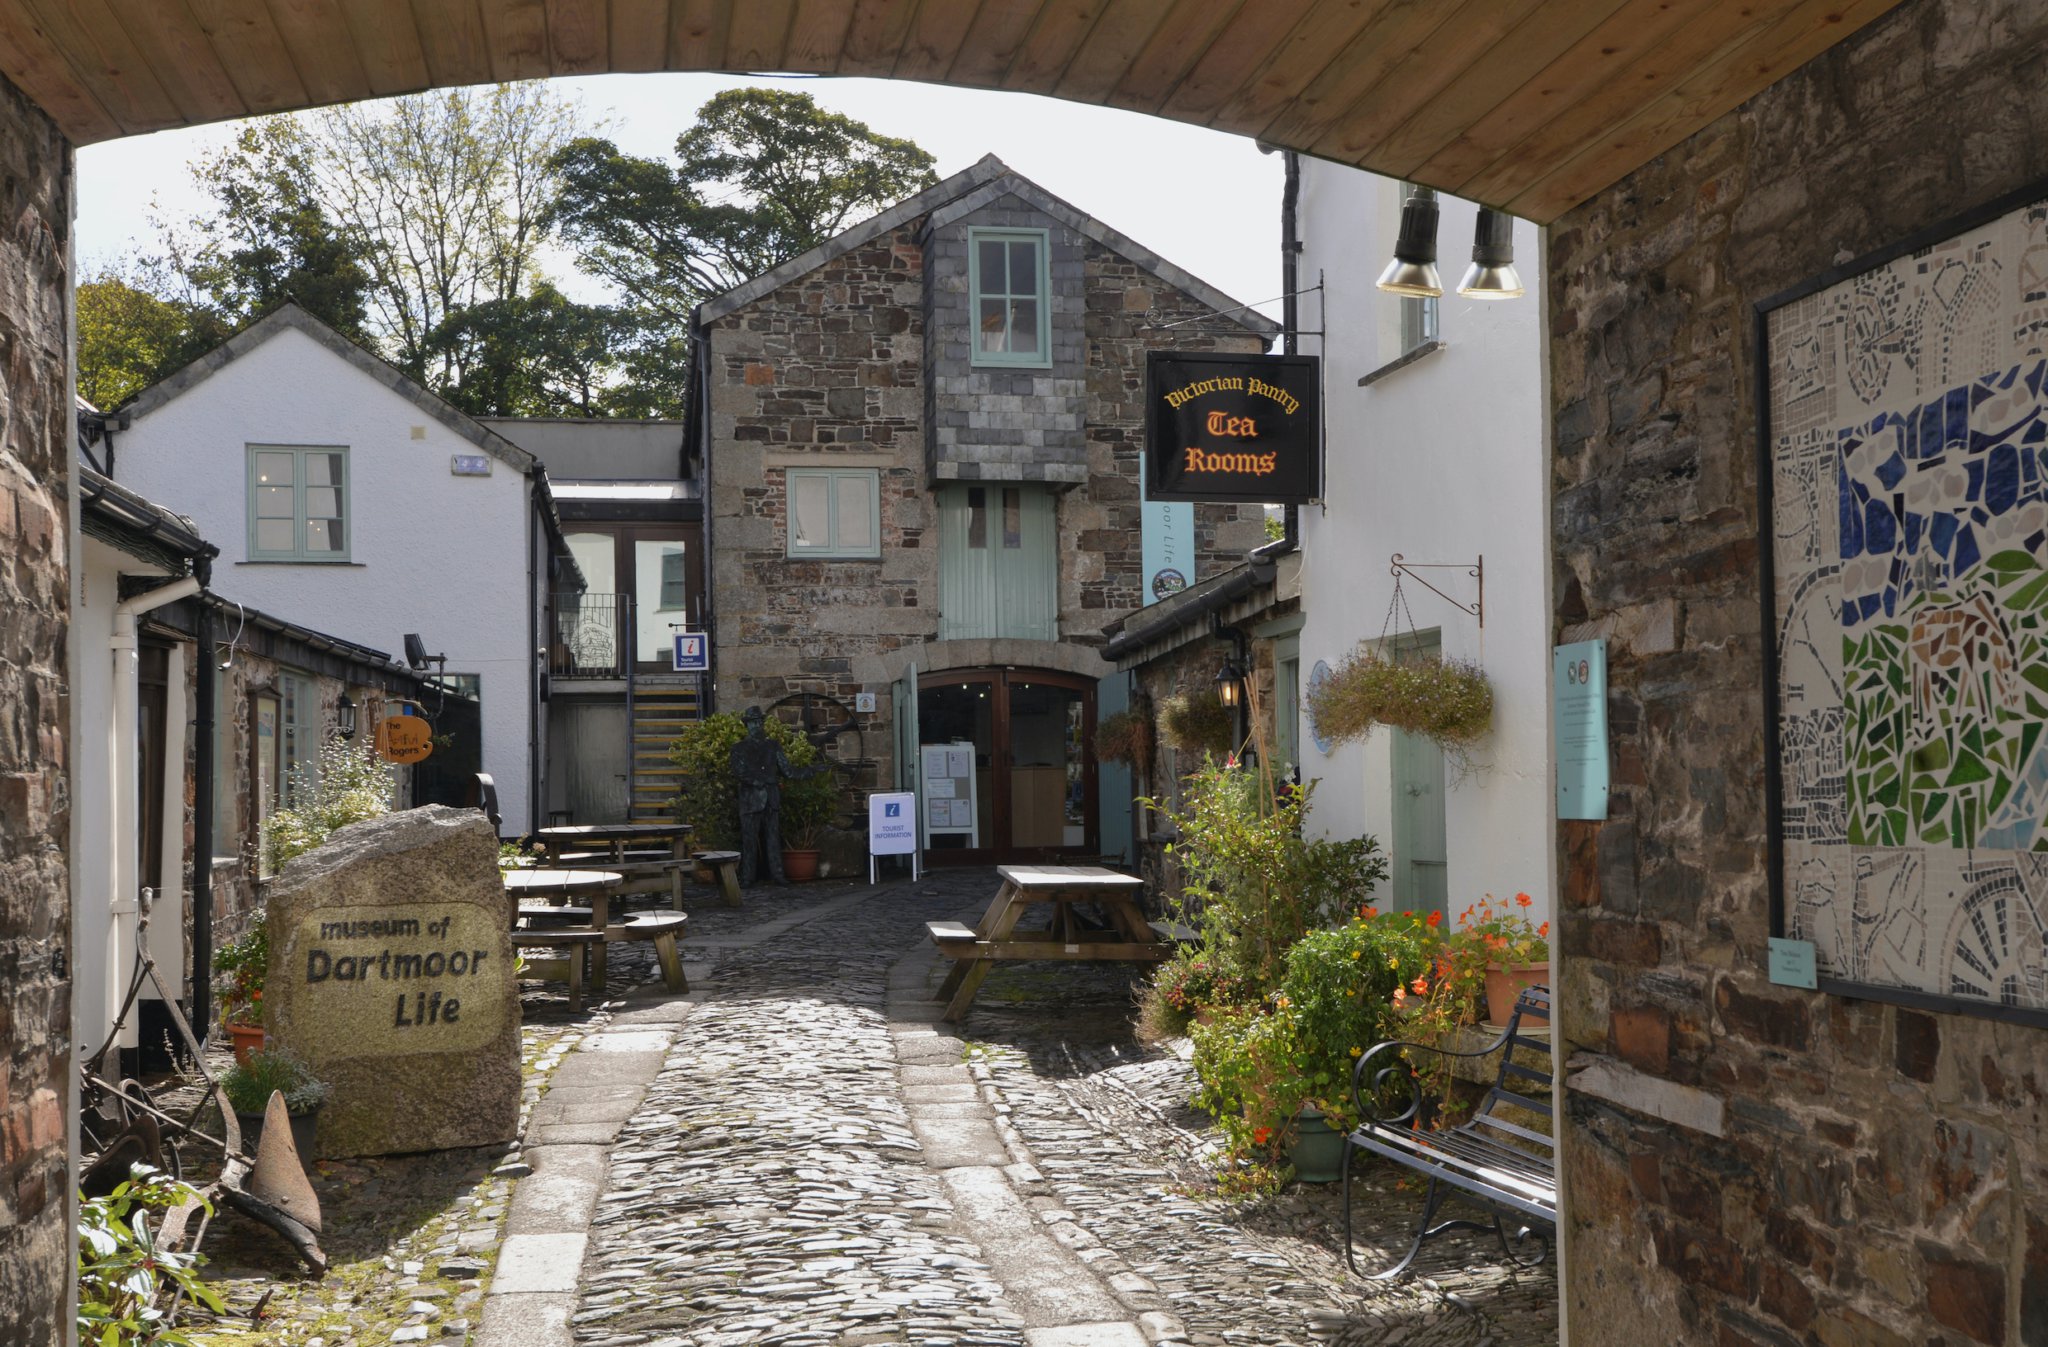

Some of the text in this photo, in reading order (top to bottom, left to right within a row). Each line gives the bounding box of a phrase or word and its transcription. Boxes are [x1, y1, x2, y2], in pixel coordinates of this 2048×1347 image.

[1163, 376, 1300, 415] Victorian Pantry
[1206, 411, 1259, 437] Tea
[1184, 447, 1277, 477] Rooms
[1163, 535, 1175, 564] Life
[321, 916, 451, 940] museum of
[306, 949, 488, 983] Dartmoor
[395, 991, 461, 1027] Life
